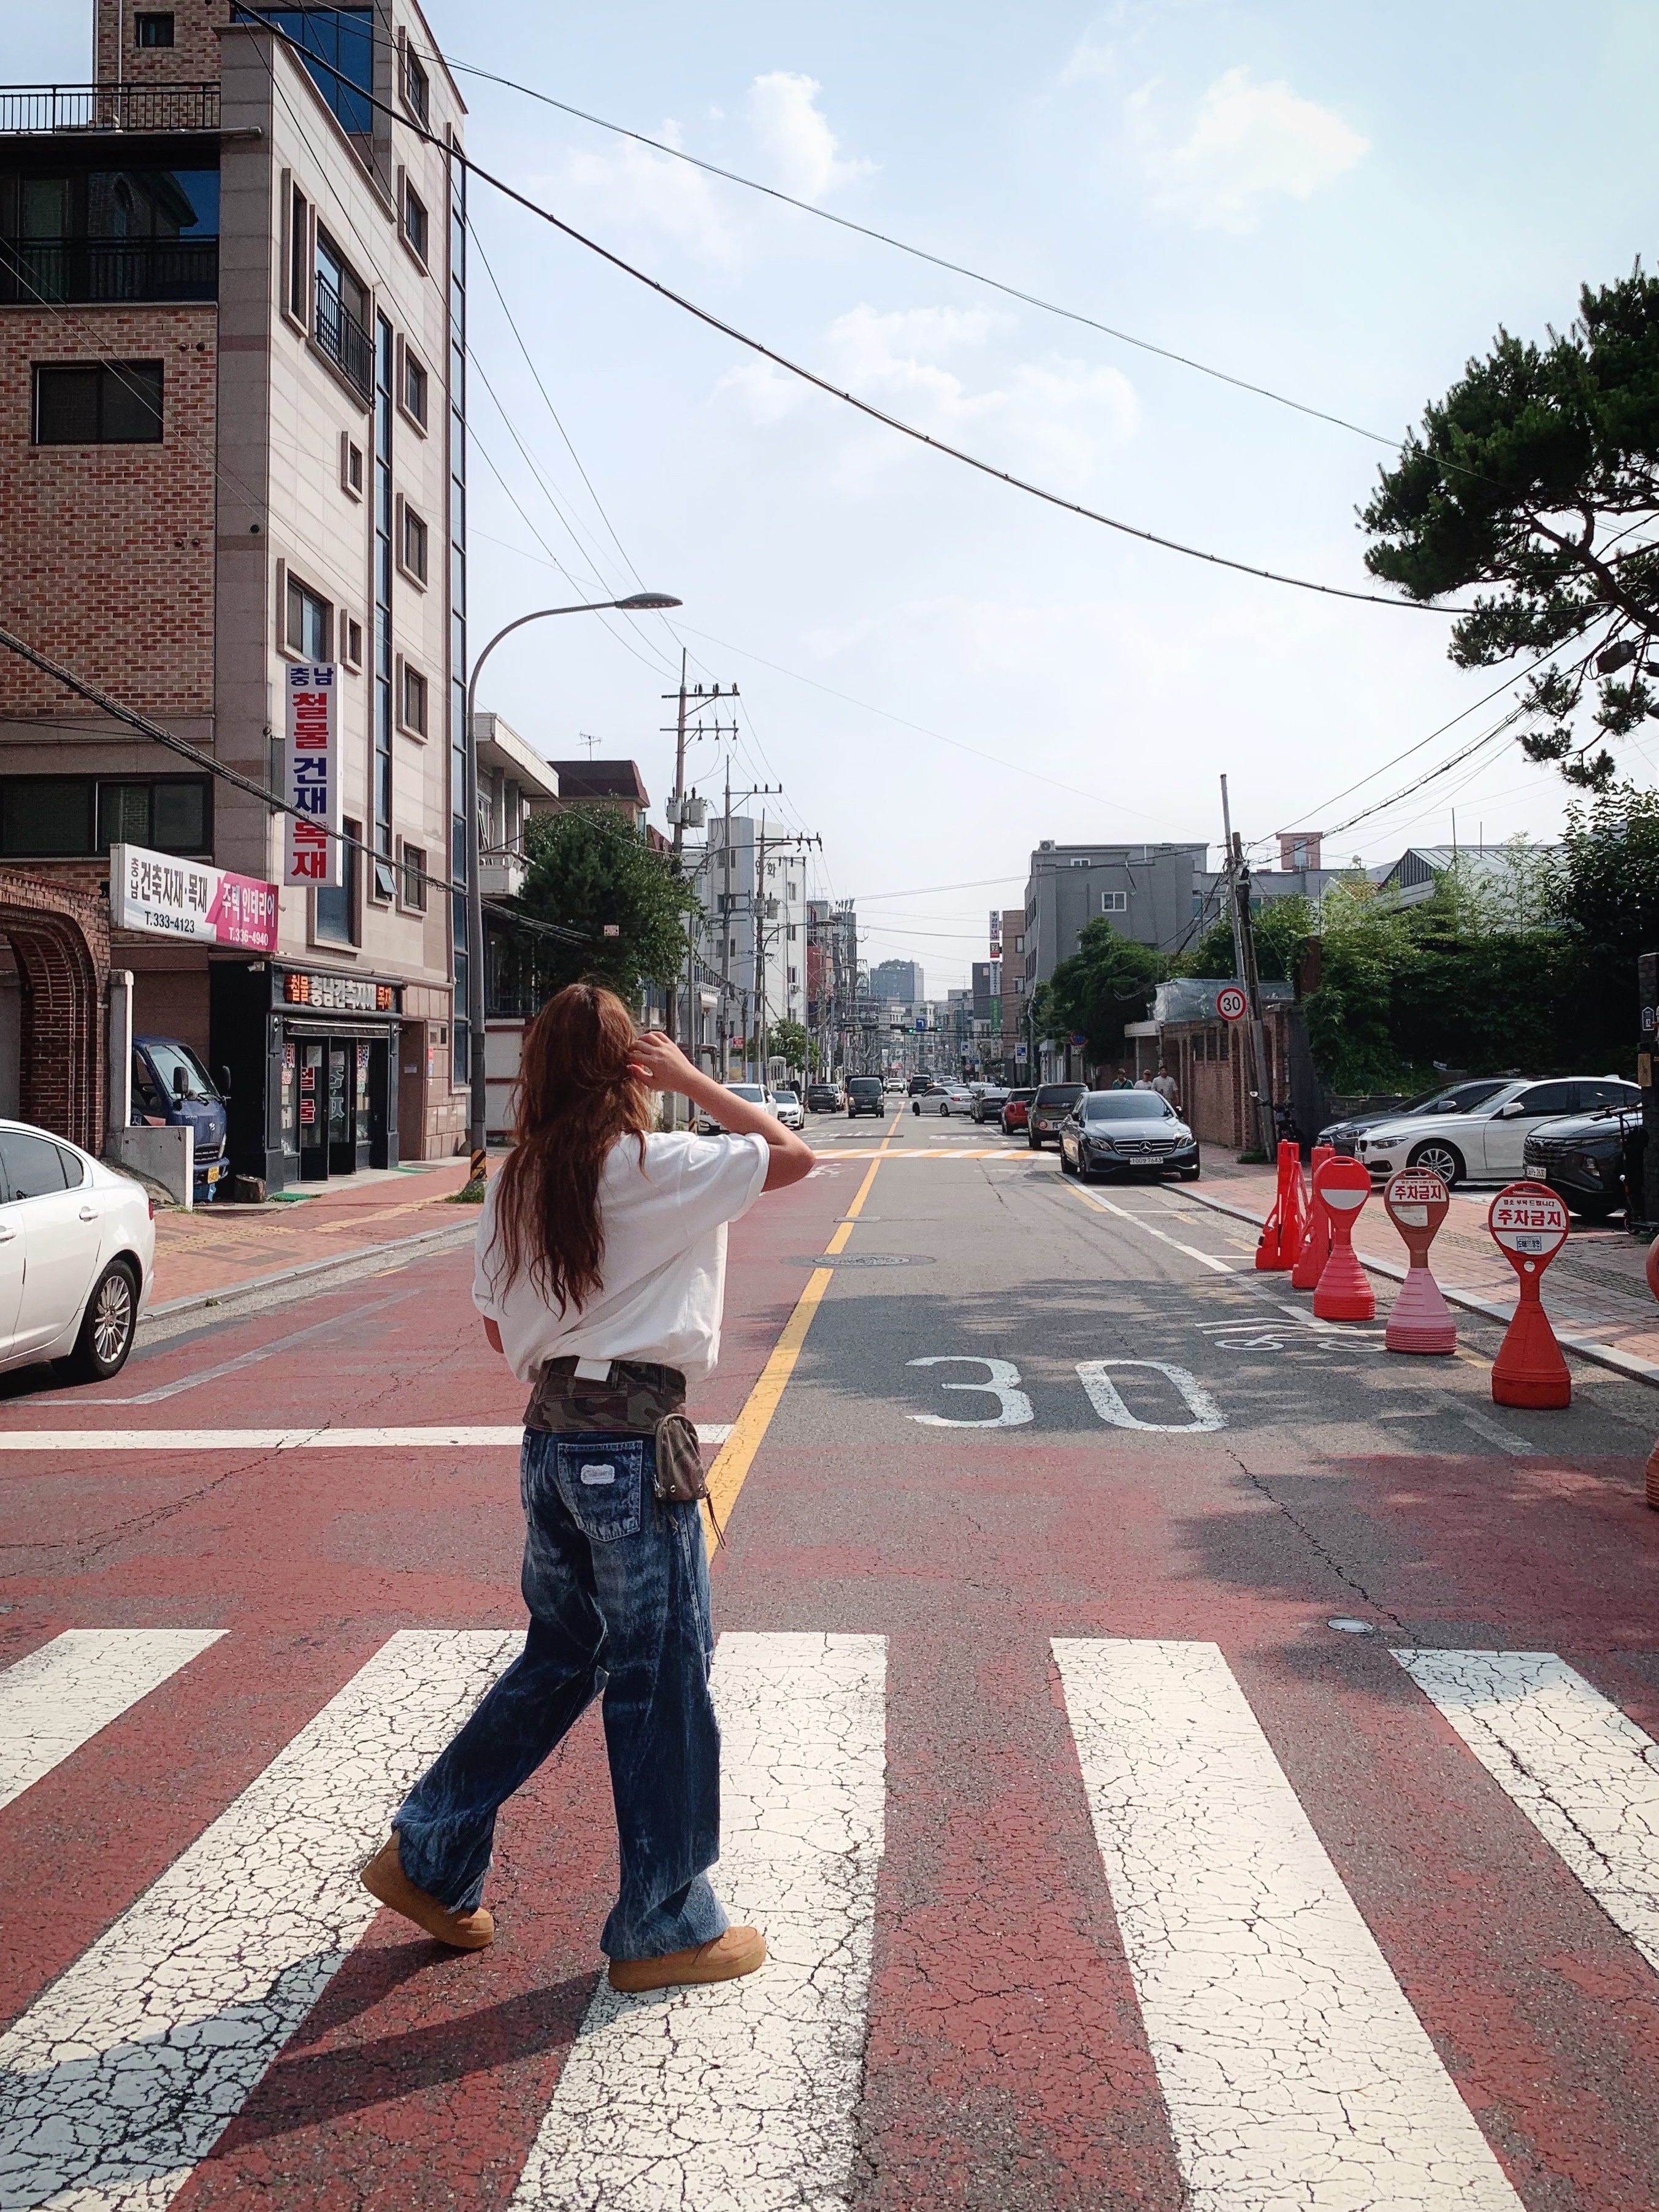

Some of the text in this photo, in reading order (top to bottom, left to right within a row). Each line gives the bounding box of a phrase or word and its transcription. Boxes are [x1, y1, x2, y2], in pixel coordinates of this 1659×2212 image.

[290, 667, 334, 686] 충남
[291, 692, 329, 879] 철물 건재 목재
[131, 858, 139, 900] 충남
[222, 882, 275, 928] 주택 인테리어
[145, 910, 195, 934] T.333-4123
[228, 926, 269, 947] T.336-4940
[291, 974, 309, 1002] 철물
[1223, 996, 1241, 1012] 30
[1395, 1185, 1441, 1200] 주차금지
[1498, 1209, 1561, 1227] 주차금지
[905, 1354, 1230, 1434] 30
